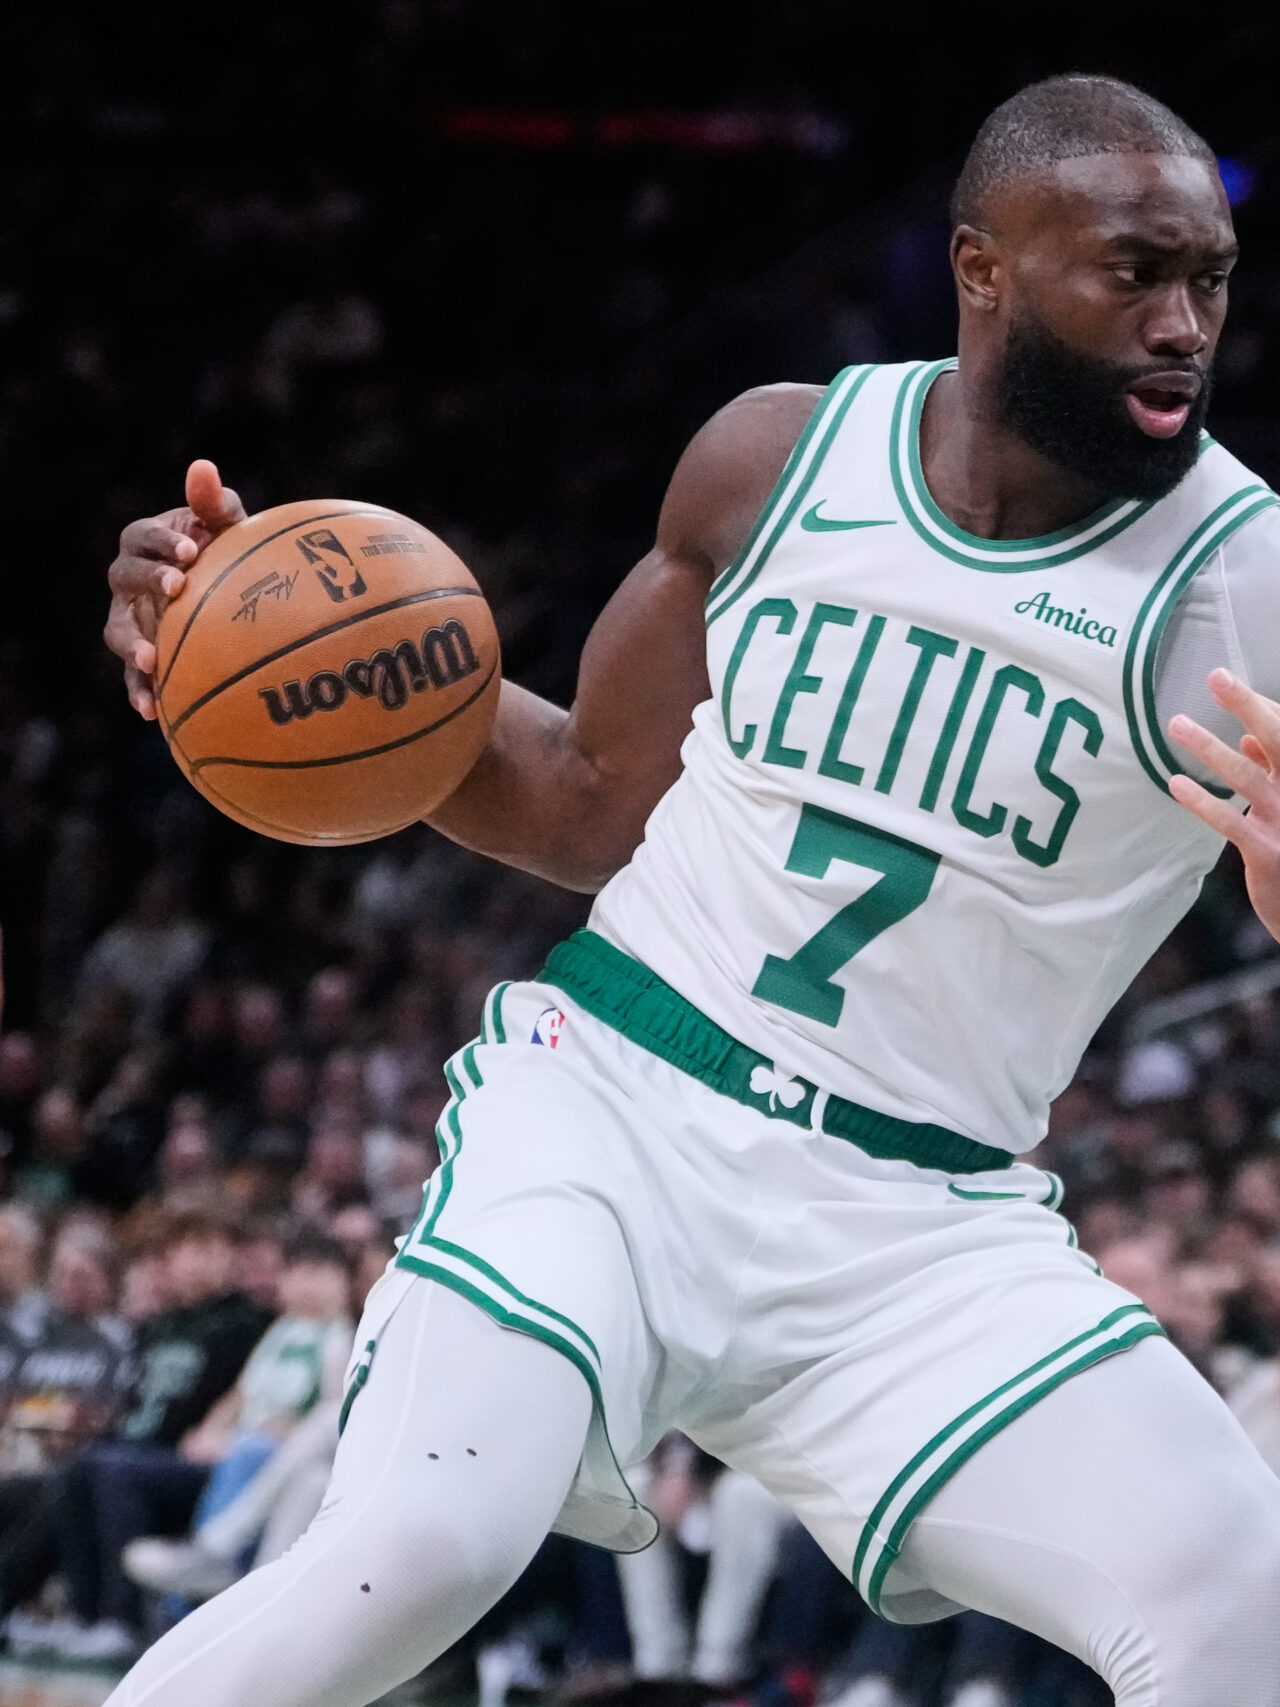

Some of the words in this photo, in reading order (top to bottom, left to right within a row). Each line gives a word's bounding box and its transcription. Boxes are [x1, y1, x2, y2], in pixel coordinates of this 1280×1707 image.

[259, 617, 480, 726] Wilson
[1014, 592, 1117, 648] Amica
[721, 597, 1104, 868] CELTICS
[751, 803, 942, 1028] 7
